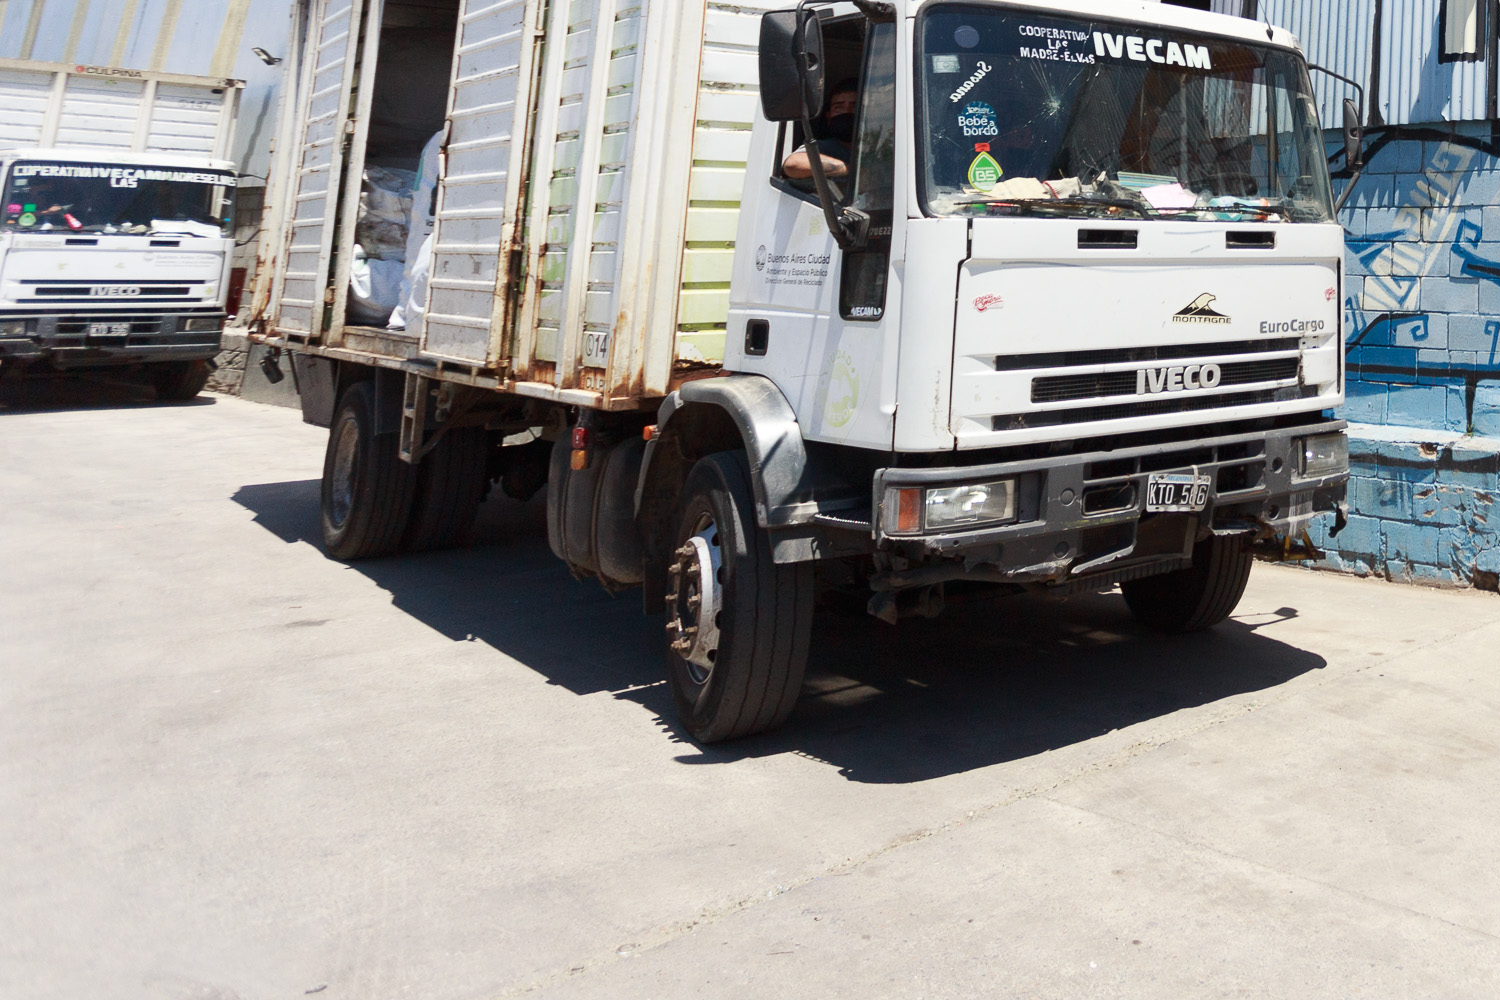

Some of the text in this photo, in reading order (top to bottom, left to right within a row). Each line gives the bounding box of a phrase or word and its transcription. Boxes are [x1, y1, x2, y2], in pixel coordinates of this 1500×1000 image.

[1019, 25, 1087, 42] COOPERATIVA
[1019, 47, 1095, 65] MADREELVAS
[1093, 31, 1212, 70] IVECAM
[86, 67, 143, 78] CULPINA
[975, 170, 996, 181] B5
[110, 178, 138, 188] LAS
[767, 253, 831, 265] Buenos Aires Ciudad
[766, 267, 787, 276] Ambiente
[792, 267, 809, 277] Espacio
[90, 287, 141, 296] IVECO
[1172, 315, 1232, 324] MONTAGNE
[1259, 319, 1325, 334] EuroCargo
[595, 334, 609, 358] 14
[1136, 363, 1222, 395] IVECO
[1149, 484, 1175, 505] KTO
